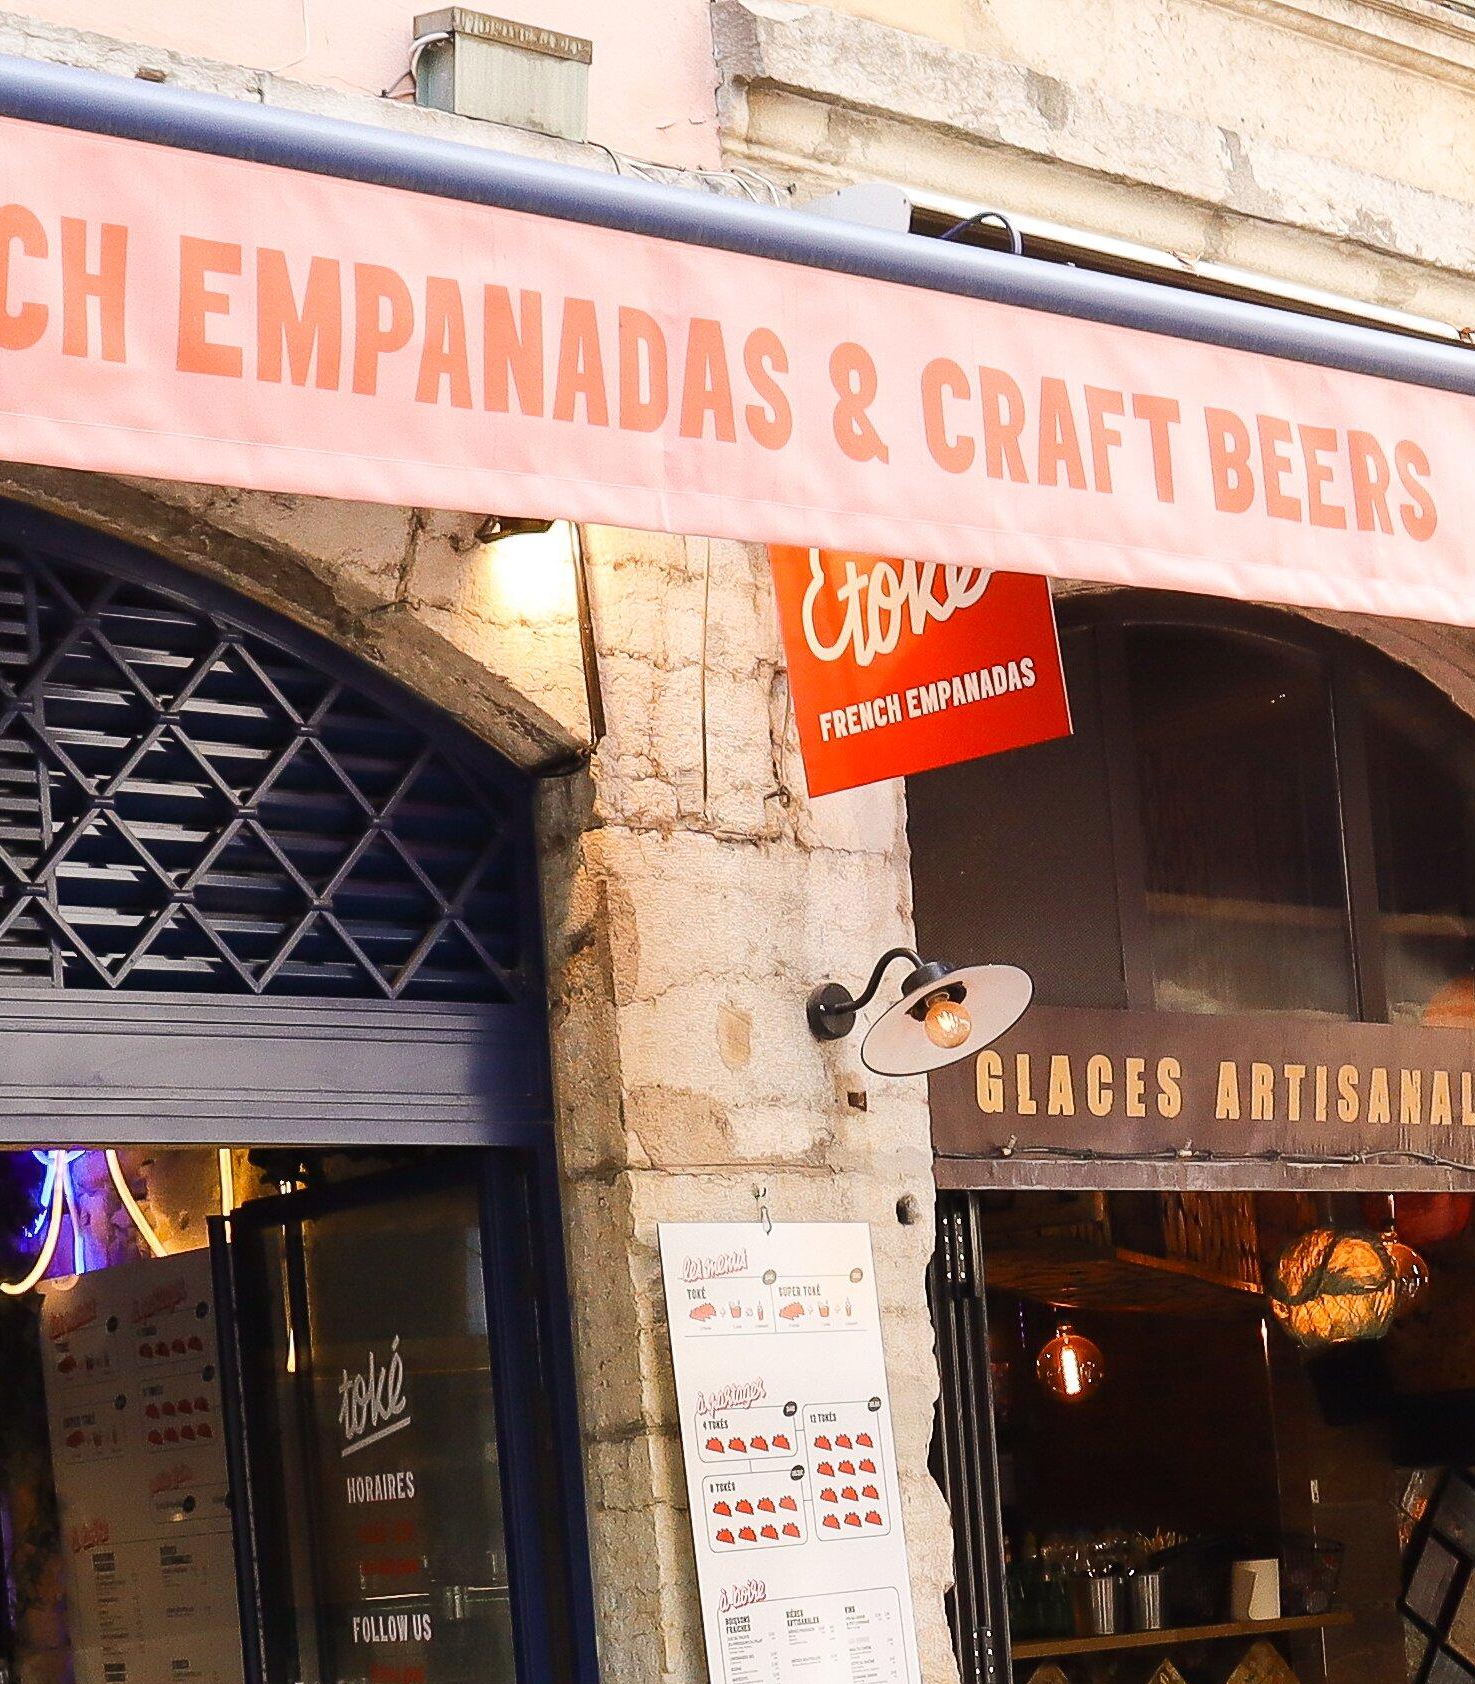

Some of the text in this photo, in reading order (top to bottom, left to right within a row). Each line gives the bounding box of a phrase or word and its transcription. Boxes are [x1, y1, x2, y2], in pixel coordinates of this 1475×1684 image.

[176, 236, 792, 451] EMPANADAS
[829, 342, 889, 464] &
[926, 358, 1181, 503] CRAFT
[1204, 408, 1439, 541] BEERS
[819, 658, 1036, 741] FRENCH EMPANADAS
[976, 1050, 1181, 1118] GLACES
[687, 1286, 706, 1300] TOKÉ
[338, 1333, 407, 1440] toké
[347, 1471, 415, 1504] HORAIRES
[352, 1613, 433, 1643] FOLLOW US
